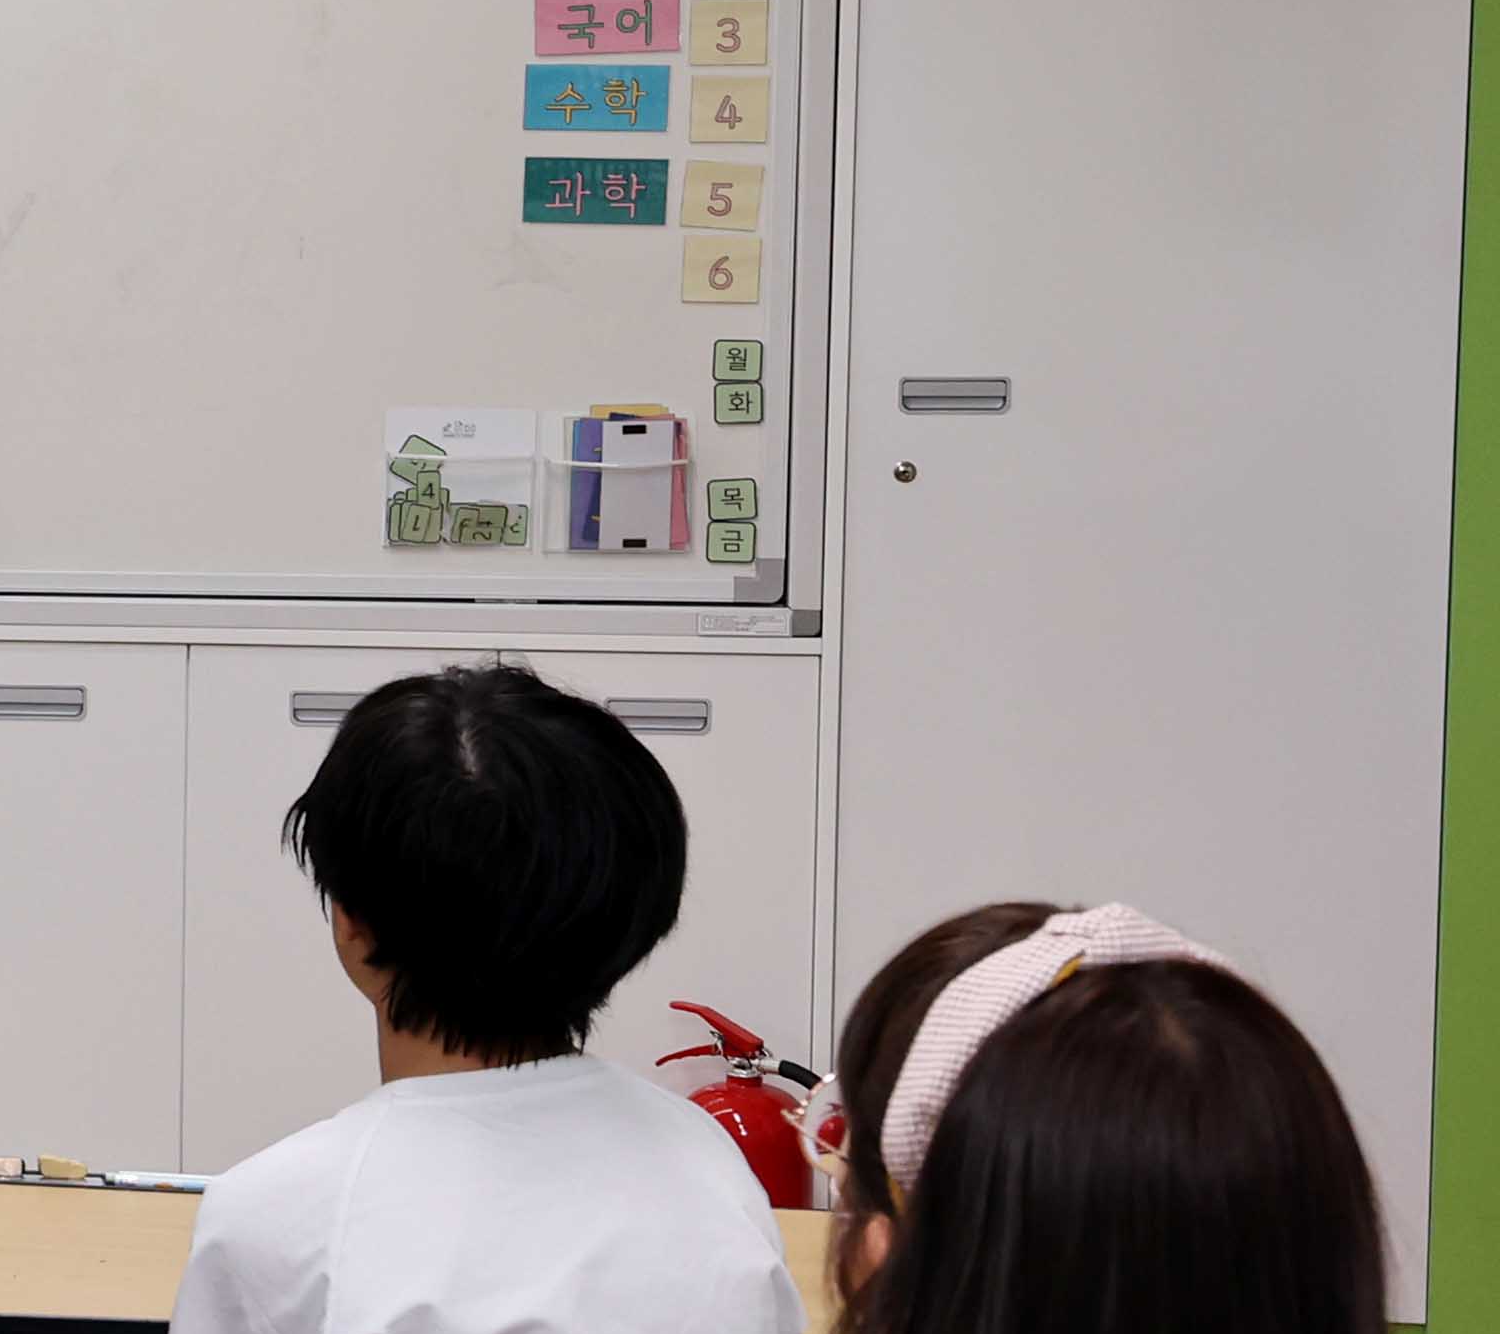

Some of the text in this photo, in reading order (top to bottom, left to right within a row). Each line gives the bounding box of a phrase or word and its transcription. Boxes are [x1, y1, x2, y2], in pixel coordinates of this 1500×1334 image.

[557, 0, 741, 53] 국어 3
[545, 78, 743, 129] 수학 4
[544, 171, 734, 219] 과학 5
[708, 255, 734, 290] 6
[727, 347, 749, 372] 월
[728, 390, 751, 414] 화
[721, 486, 745, 511] 목
[721, 529, 745, 553] 금
